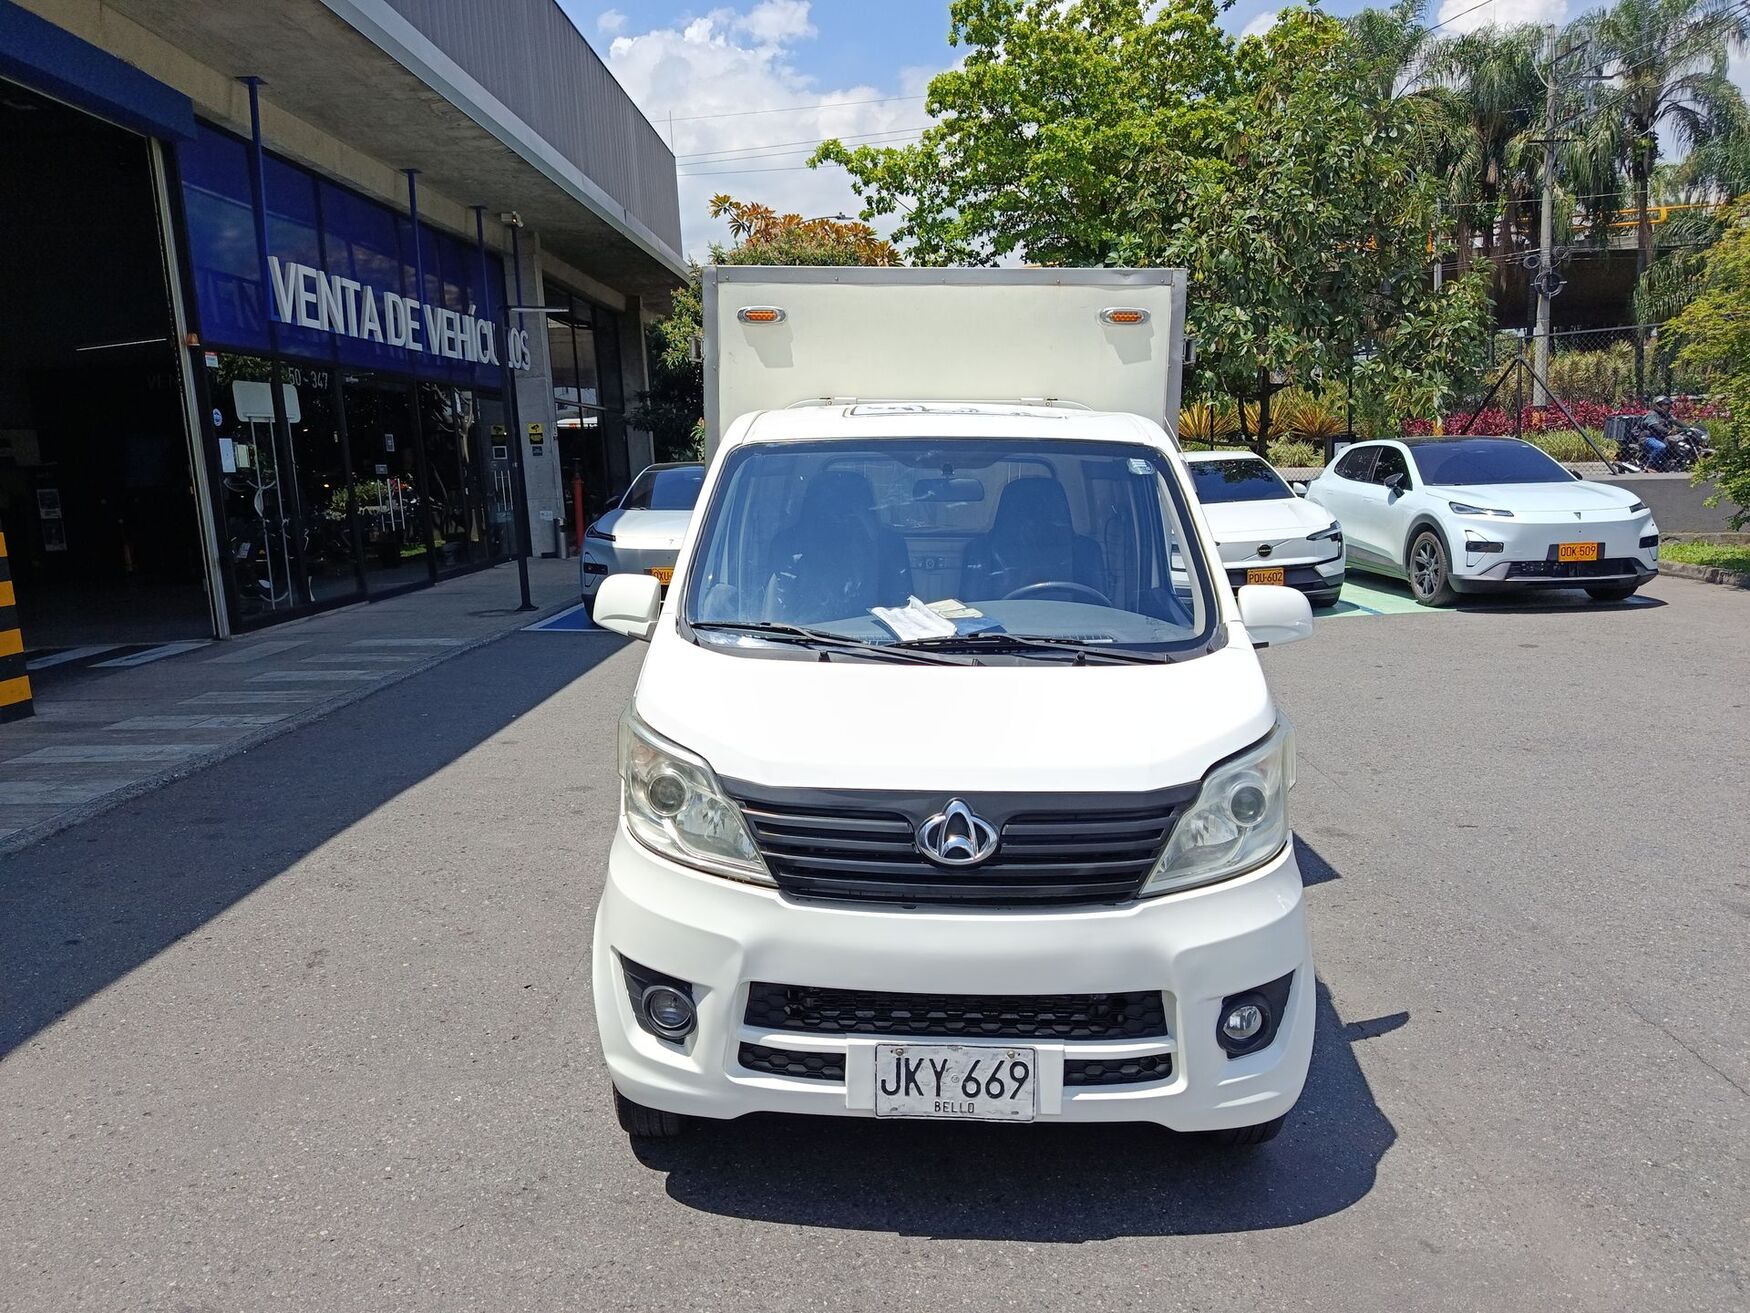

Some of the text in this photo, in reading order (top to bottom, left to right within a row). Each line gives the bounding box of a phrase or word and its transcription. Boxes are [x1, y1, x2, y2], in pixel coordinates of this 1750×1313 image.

[267, 255, 384, 344] VENTA
[384, 291, 423, 352] DE
[423, 304, 531, 372] VEHÍCUOS
[310, 370, 328, 390] 347
[881, 1057, 1030, 1100] JKY 669
[934, 1101, 975, 1113] BELLO
